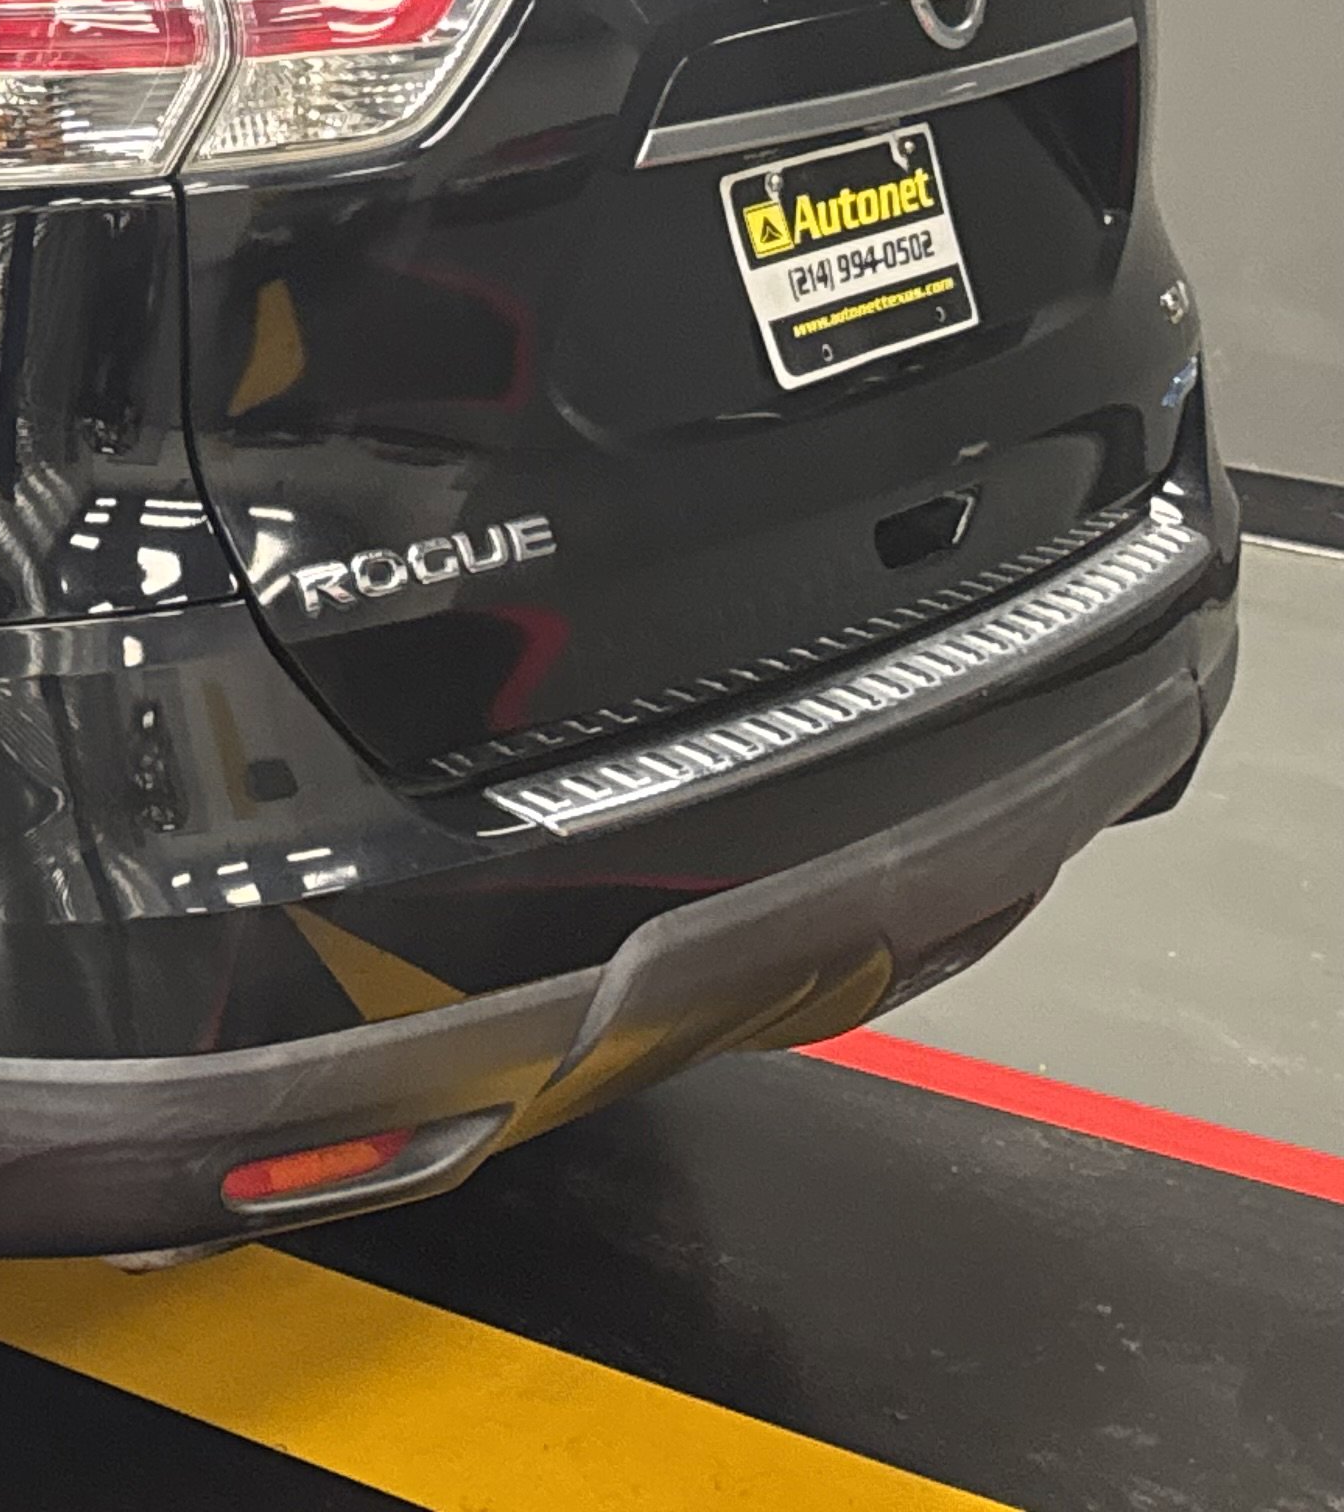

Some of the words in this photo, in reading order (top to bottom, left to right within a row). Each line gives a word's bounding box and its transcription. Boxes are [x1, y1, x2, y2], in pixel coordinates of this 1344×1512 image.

[794, 168, 934, 244] Autonet
[787, 258, 835, 302] (214)
[837, 230, 935, 284] 994-0502
[293, 513, 557, 618] ROGUE
